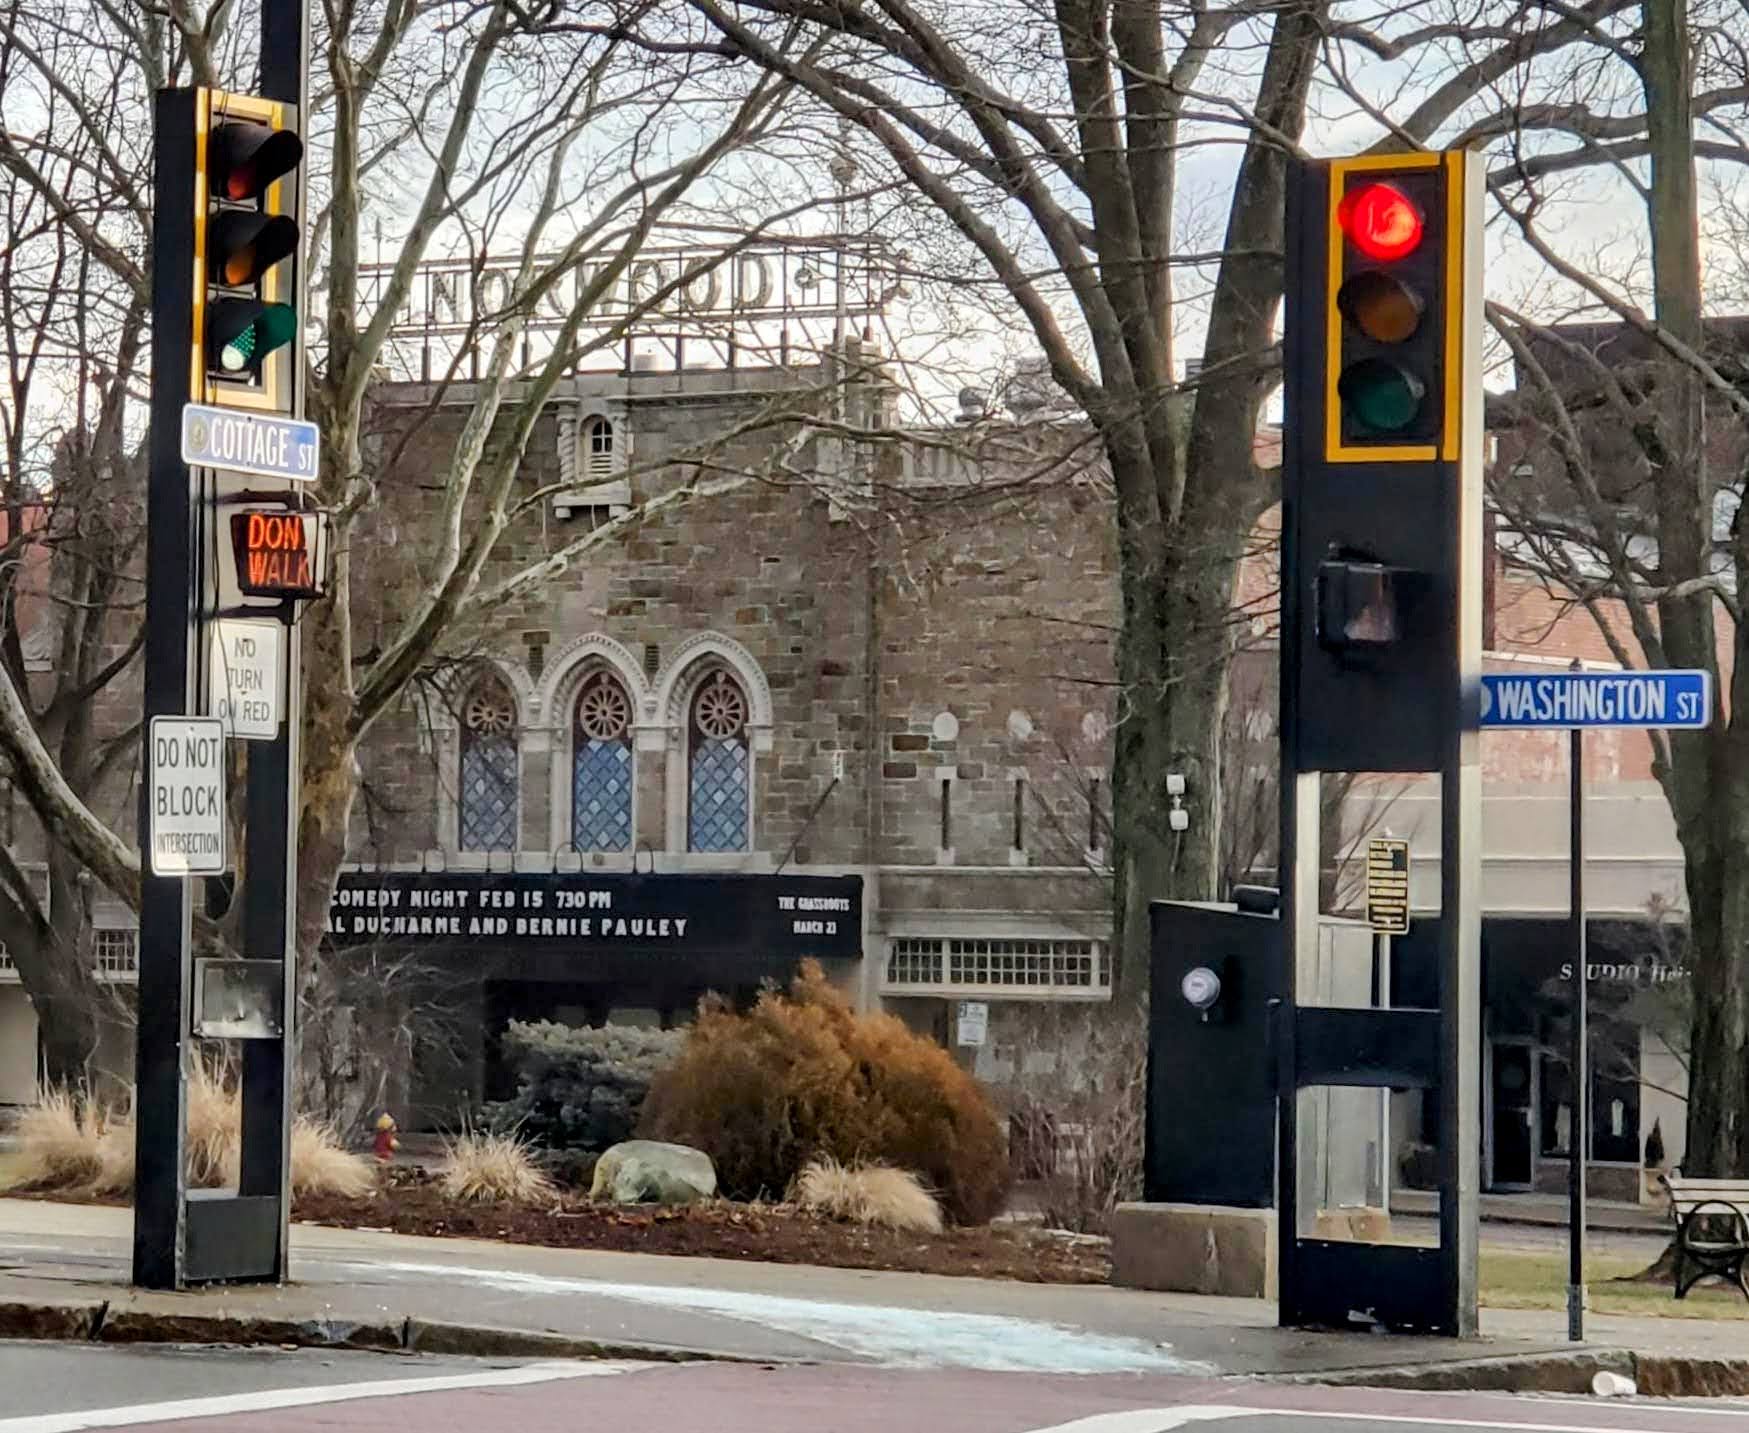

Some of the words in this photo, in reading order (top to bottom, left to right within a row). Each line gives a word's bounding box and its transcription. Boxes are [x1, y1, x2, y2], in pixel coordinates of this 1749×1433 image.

[432, 254, 774, 323] NOWOOD
[210, 417, 291, 468] COTTAGE
[299, 443, 314, 470] ST
[248, 513, 301, 551] DON
[248, 551, 312, 587] WALK
[234, 637, 256, 658] NO
[227, 667, 263, 690] TURN
[218, 698, 237, 719] ON
[243, 700, 270, 722] RED
[1497, 679, 1666, 721] WASHINGTON
[1676, 692, 1699, 720] ST
[157, 737, 179, 768] DO
[185, 737, 218, 768] NOT
[157, 785, 218, 817] BLOCK
[157, 832, 219, 854] INTERSECTION
[410, 890, 469, 908] NIGHT
[479, 890, 515, 908] FEB
[523, 891, 543, 908] 15
[778, 896, 796, 910] THE
[353, 916, 461, 935] DUCHARME
[469, 917, 509, 935] AND
[516, 917, 592, 936] BERNIE
[601, 918, 688, 937] PAULEY
[793, 919, 824, 934] MARCH
[1559, 963, 1640, 980] SUDIO
[1650, 964, 1692, 982] Hai
